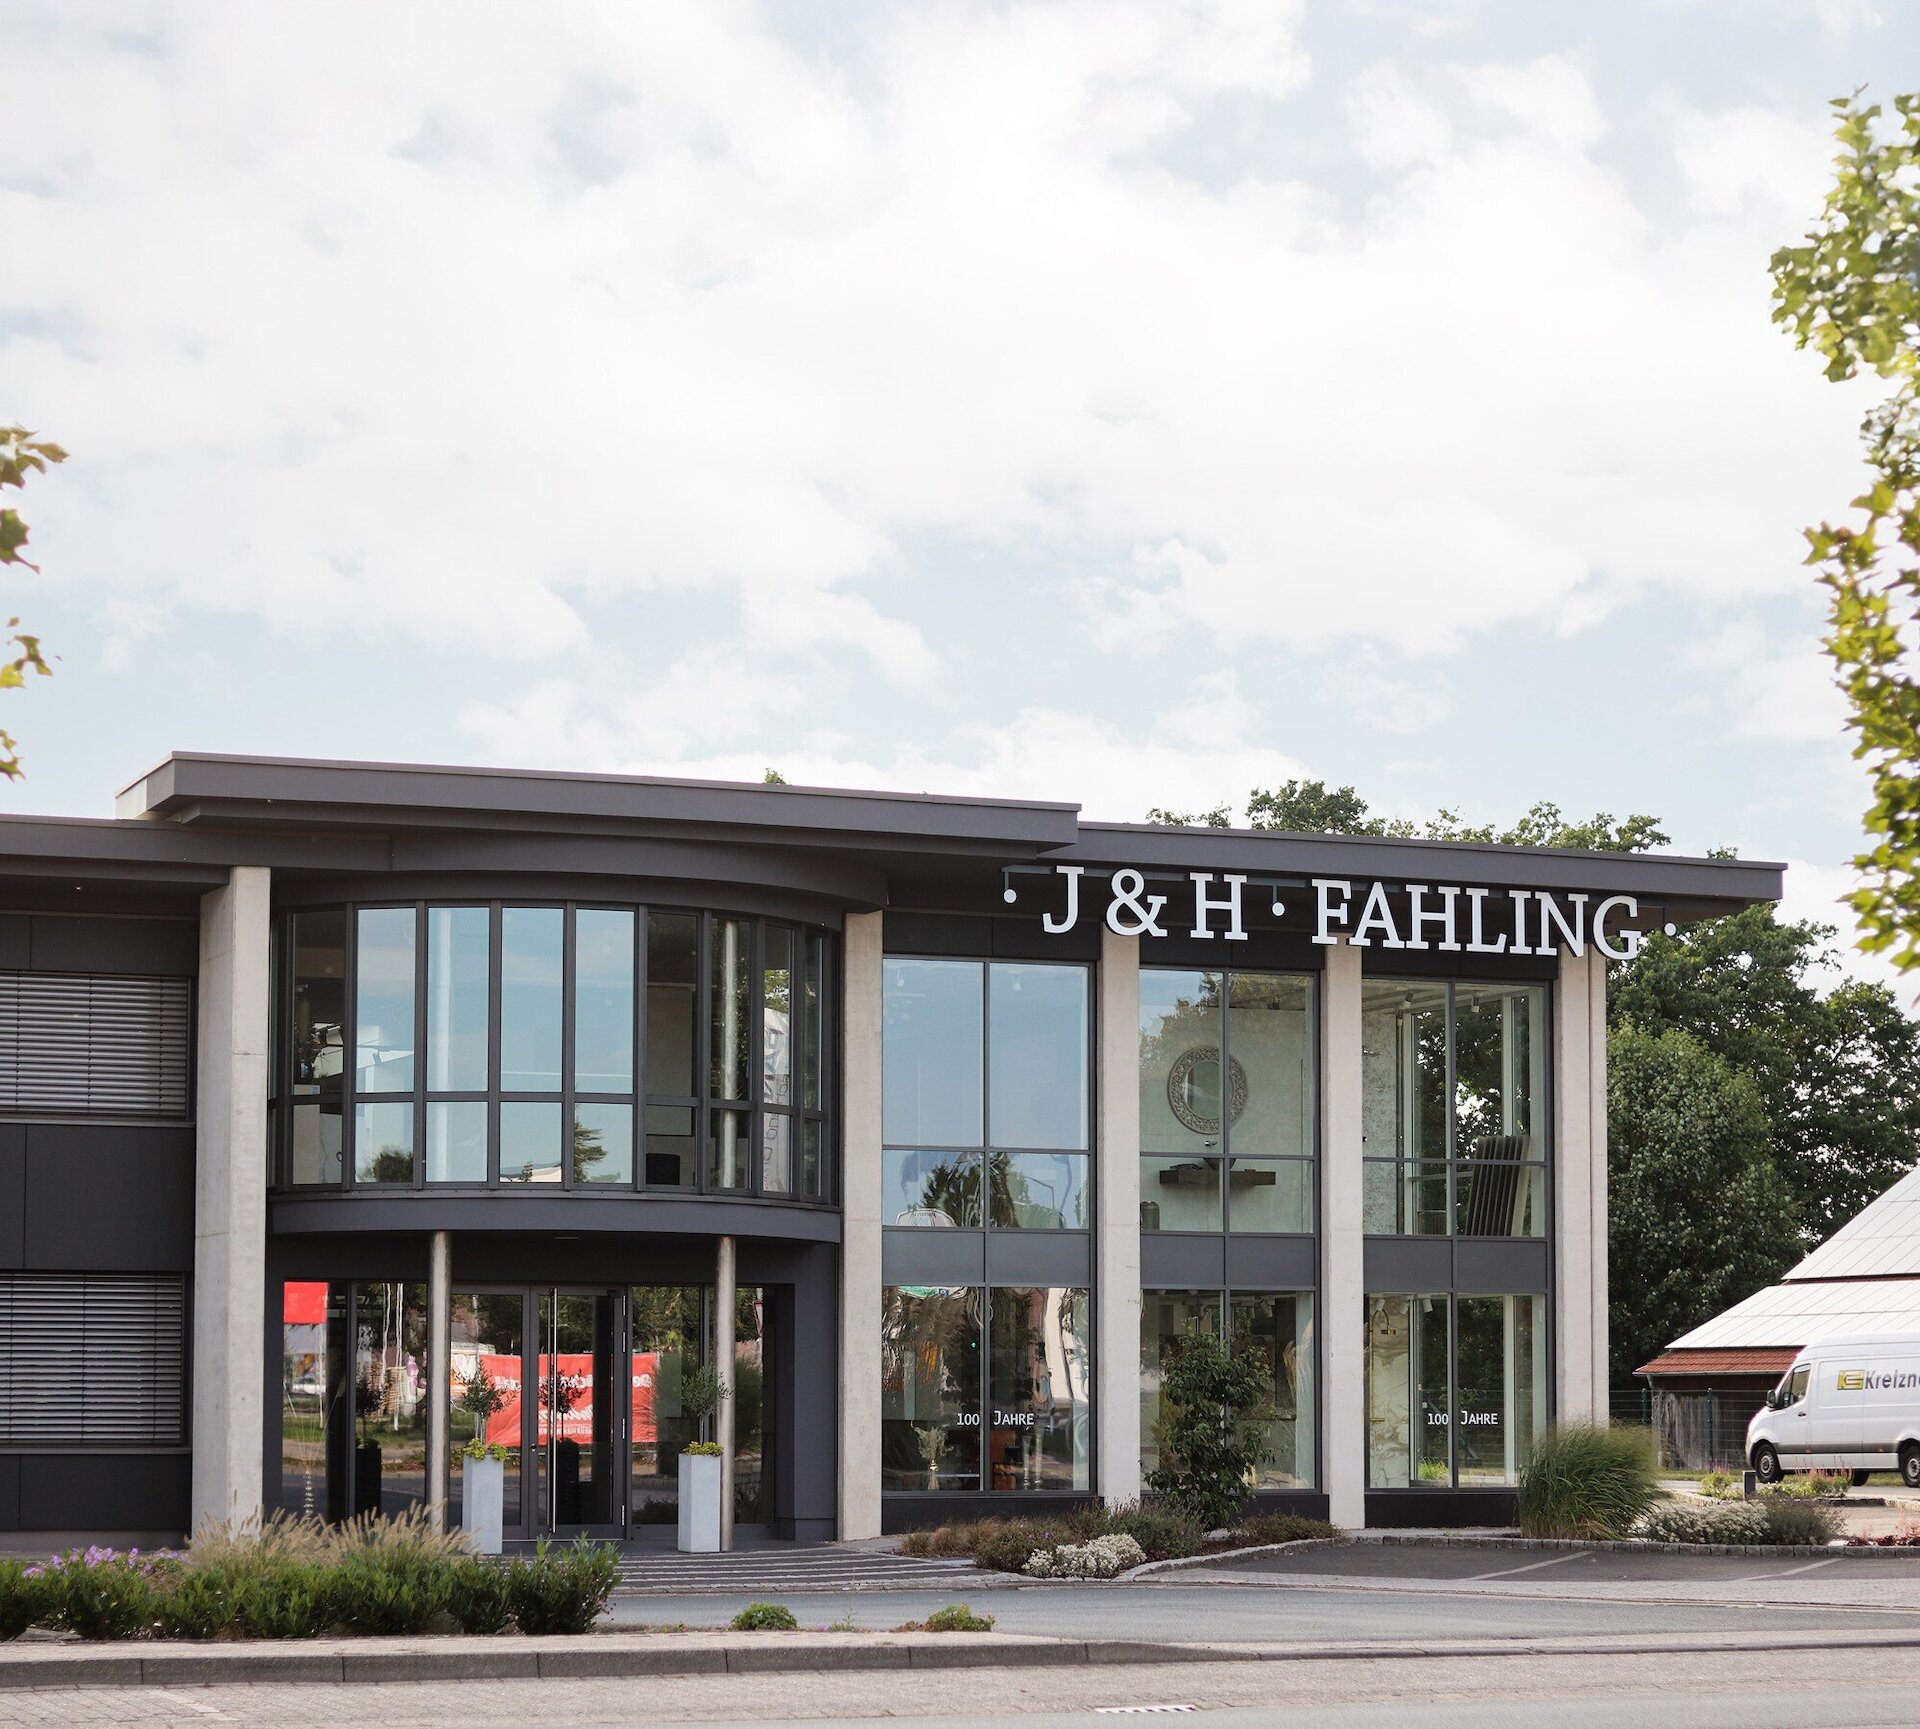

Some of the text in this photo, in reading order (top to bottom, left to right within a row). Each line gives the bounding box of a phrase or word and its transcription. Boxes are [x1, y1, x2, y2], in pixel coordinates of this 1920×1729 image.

[1042, 865, 1641, 961] J & H FAHLING
[1865, 1369, 1920, 1390] Kreizn
[956, 1410, 1035, 1426] 100 JAHRE
[1427, 1409, 1498, 1425] 100 JAHRE
